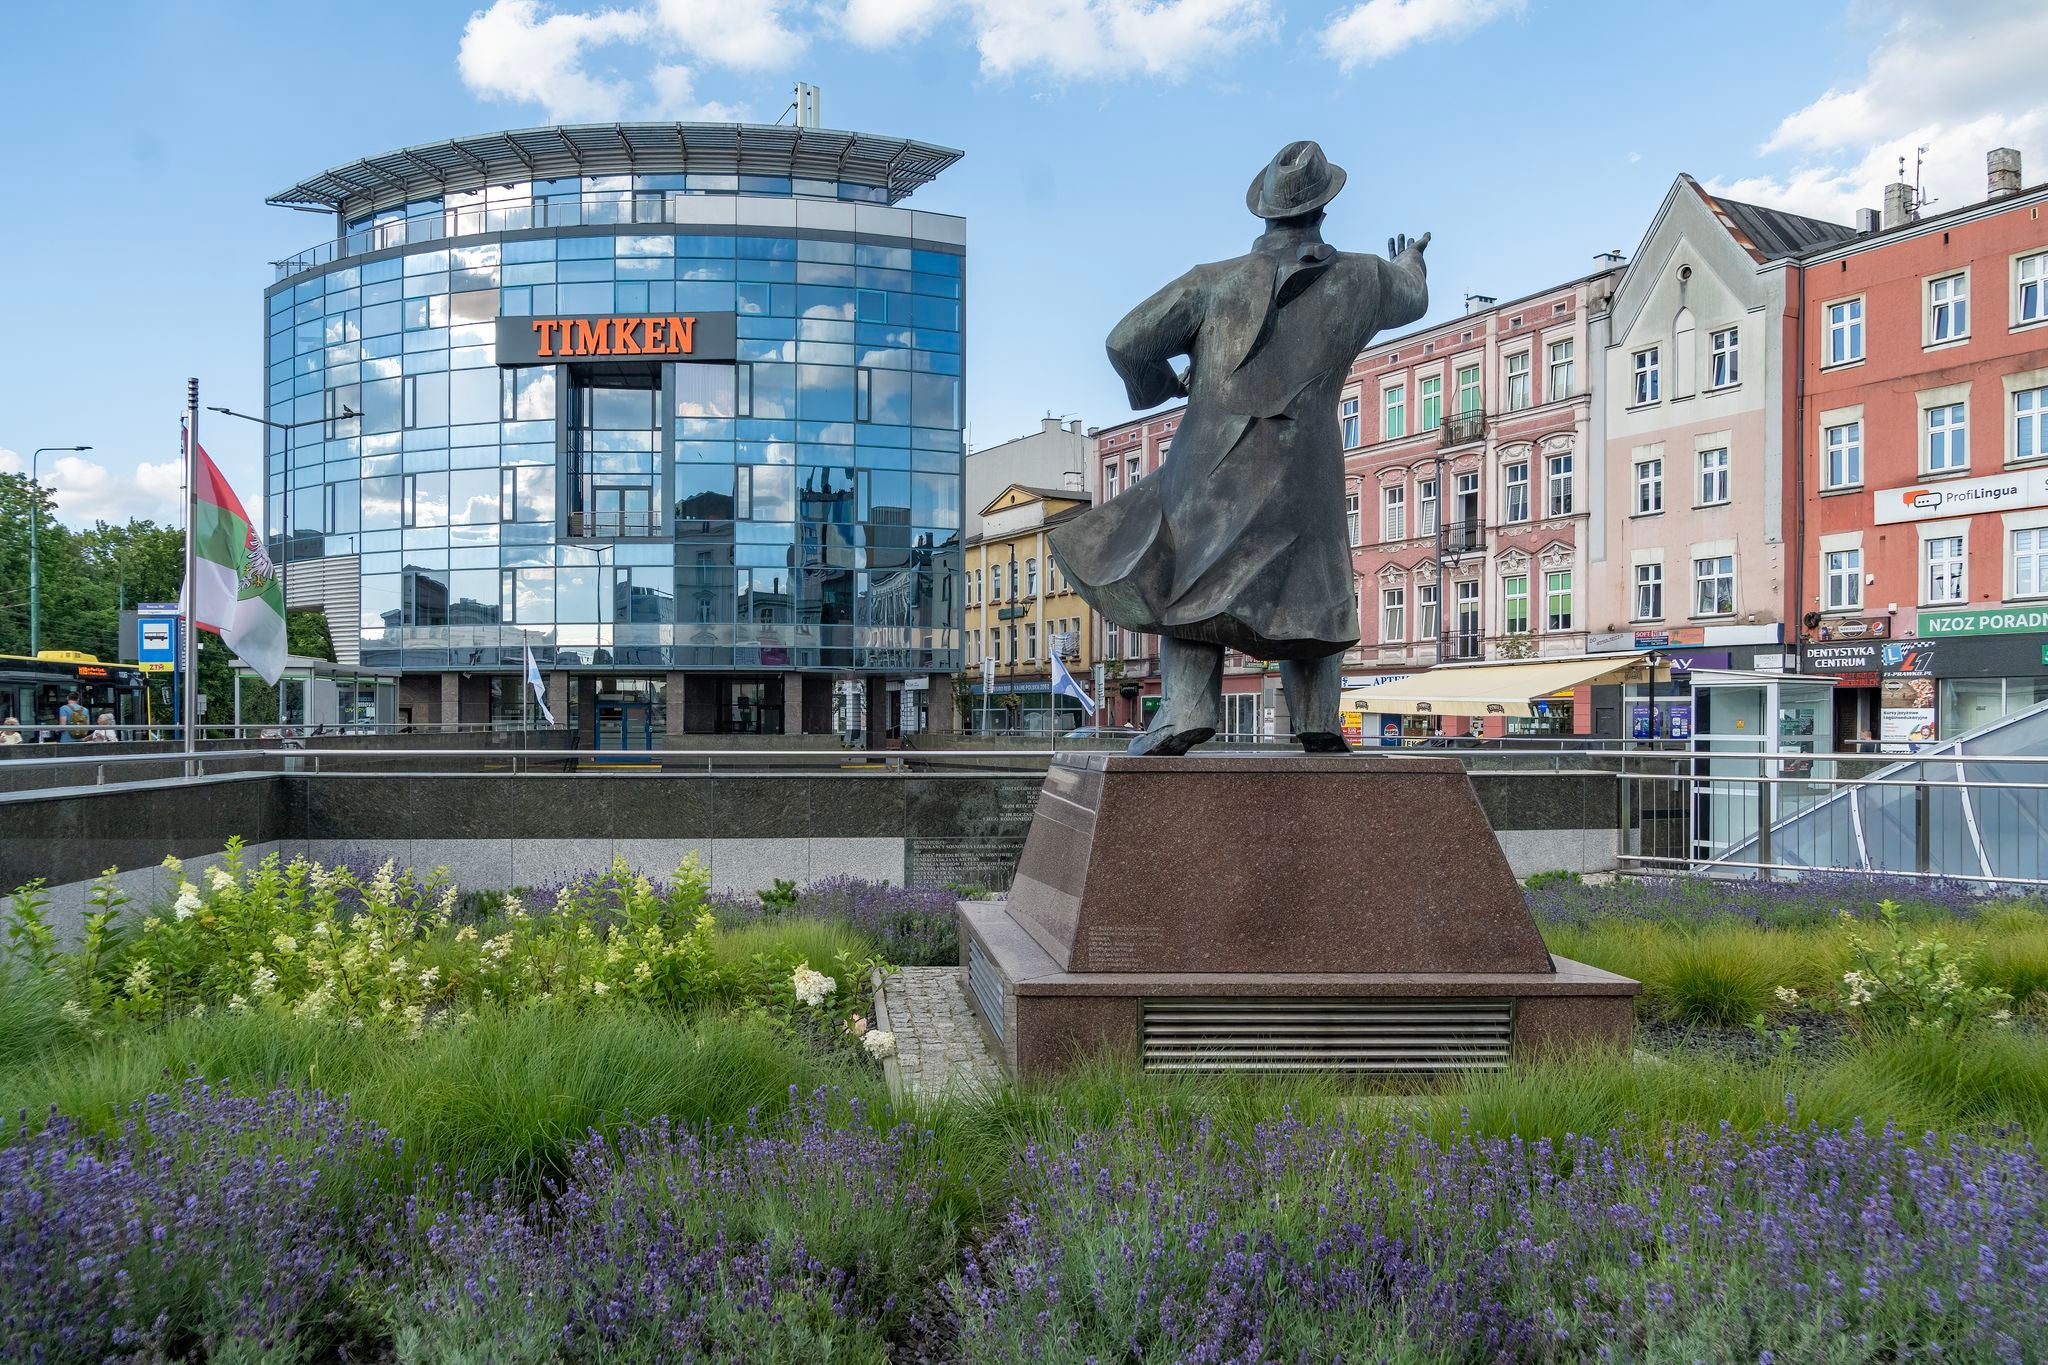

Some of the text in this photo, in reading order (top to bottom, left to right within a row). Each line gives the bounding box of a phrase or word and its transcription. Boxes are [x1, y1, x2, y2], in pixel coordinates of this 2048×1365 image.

[532, 317, 696, 356] TIMKEN
[1946, 486, 2018, 503] ProfiLingua
[1929, 616, 1975, 632] NZOZ
[1807, 647, 1875, 658] DENTYSTYKA
[1671, 658, 1693, 669] AY
[1814, 658, 1866, 668] CENTRUM
